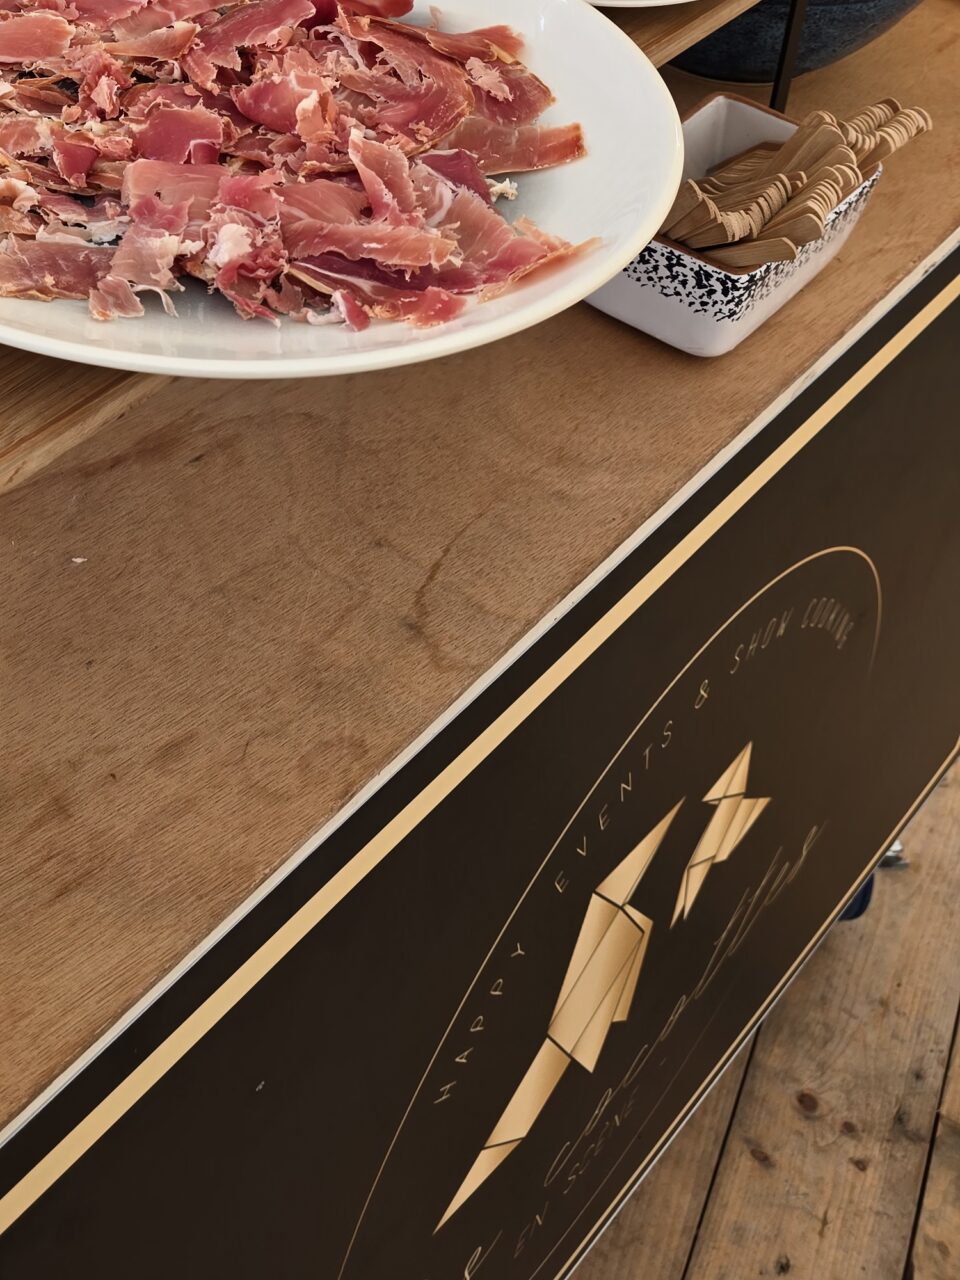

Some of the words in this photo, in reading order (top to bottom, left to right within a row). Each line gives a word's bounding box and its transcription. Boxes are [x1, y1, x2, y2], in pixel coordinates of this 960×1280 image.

[432, 941, 526, 1104] HAPPY
[554, 720, 673, 894] EVENTS
[693, 679, 711, 710] &
[729, 606, 795, 675] SHOW
